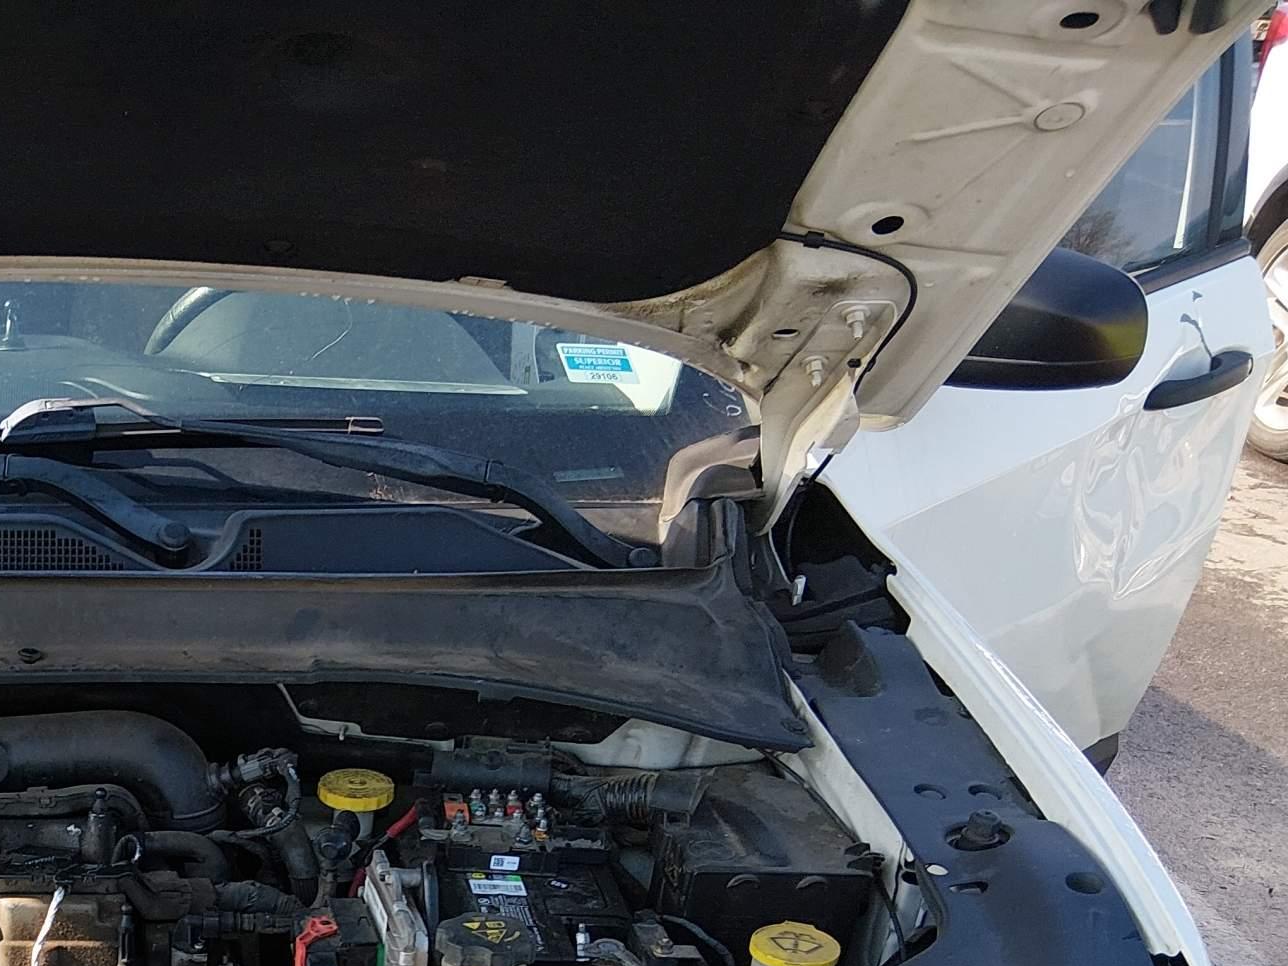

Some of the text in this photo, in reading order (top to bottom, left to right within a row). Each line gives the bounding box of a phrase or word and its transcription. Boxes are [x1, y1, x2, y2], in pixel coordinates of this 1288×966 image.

[563, 347, 624, 356] PARKING PERMIT
[574, 358, 622, 366] SUPERIOR
